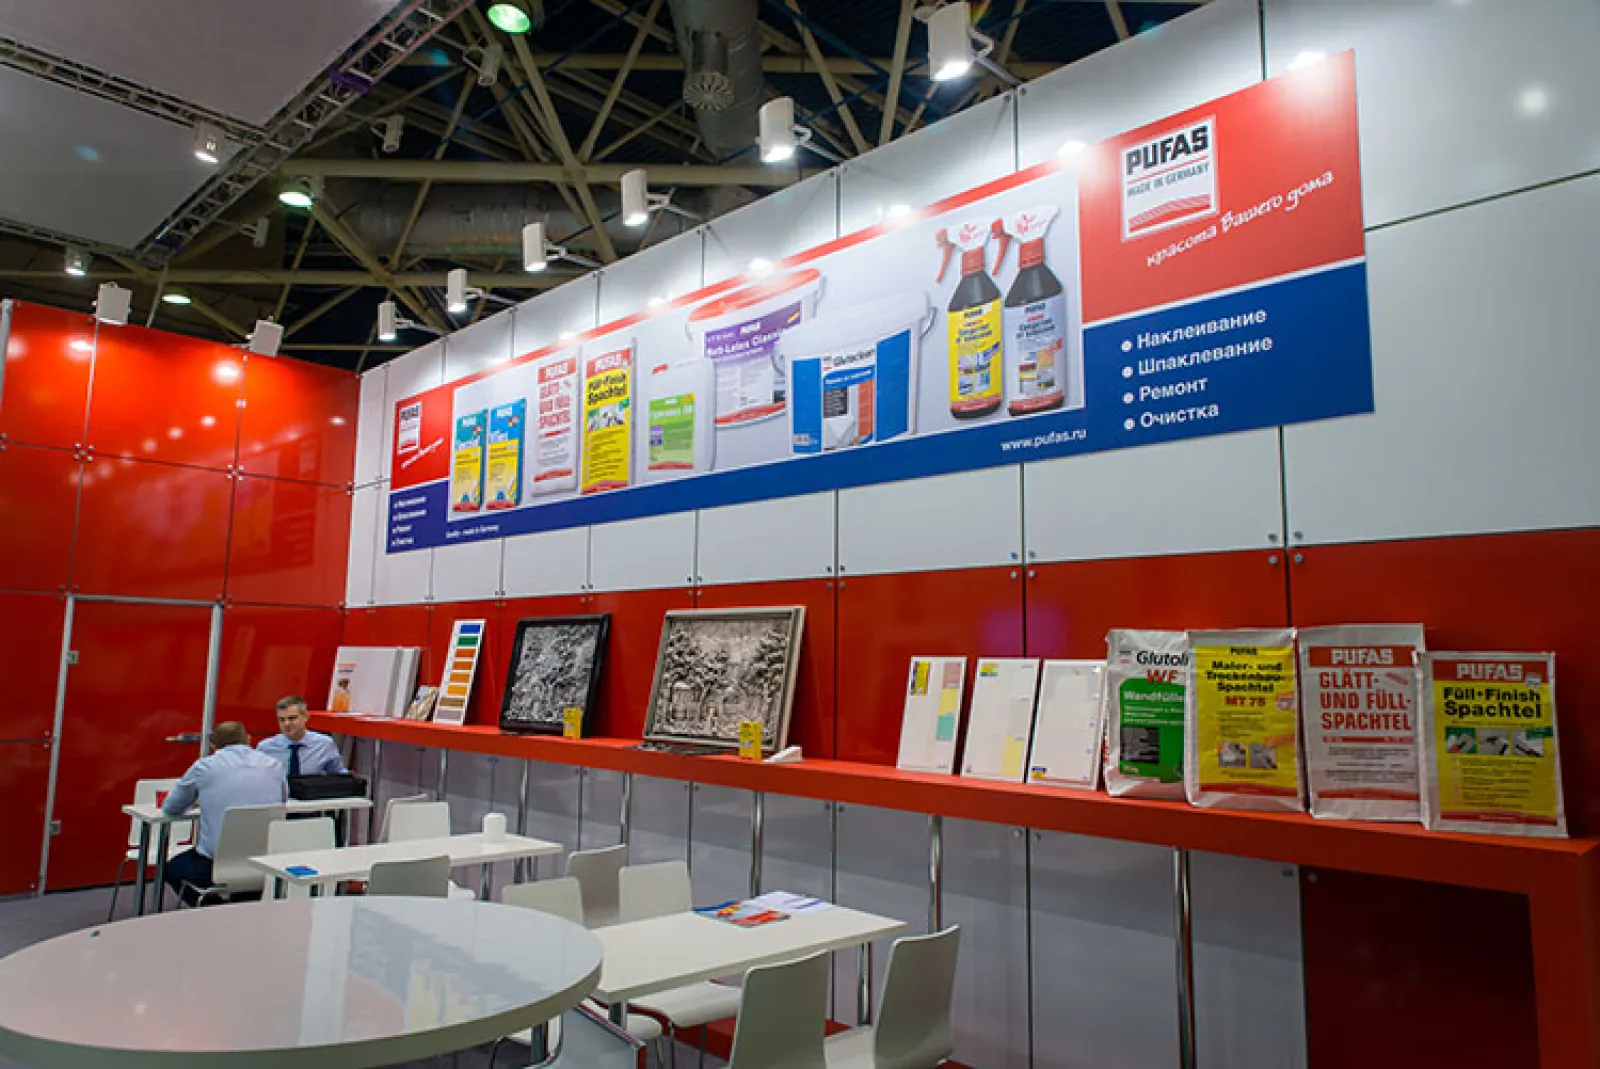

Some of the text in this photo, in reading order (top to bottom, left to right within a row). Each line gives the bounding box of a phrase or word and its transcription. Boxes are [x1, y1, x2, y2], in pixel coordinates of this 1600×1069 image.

[1126, 125, 1209, 175] PUFAS
[1128, 162, 1209, 196] MADE IN GERMANY
[1147, 225, 1218, 267] красота
[1220, 194, 1283, 233] Вашего
[1136, 308, 1268, 349] Наклеивание
[1138, 336, 1274, 376] Шпаклевание
[1139, 376, 1209, 402] Ремонт
[1140, 402, 1220, 428] Очистка
[1001, 428, 1087, 451] www.pufas.ru
[1136, 650, 1189, 666] Glutoli
[1211, 661, 1283, 671] Maler- und
[1331, 648, 1394, 665] PUFAS
[1146, 669, 1178, 685] WF
[1206, 671, 1286, 682] Trockenbau-
[1319, 667, 1379, 690] GLÄTT-
[1456, 663, 1523, 680] PUFAS
[1217, 682, 1275, 694] Spachtel
[1225, 695, 1246, 707] MT
[1320, 688, 1412, 711] UND FÜLL-
[1444, 700, 1542, 719] Spachtel
[1321, 711, 1412, 731] SPACHTEL
